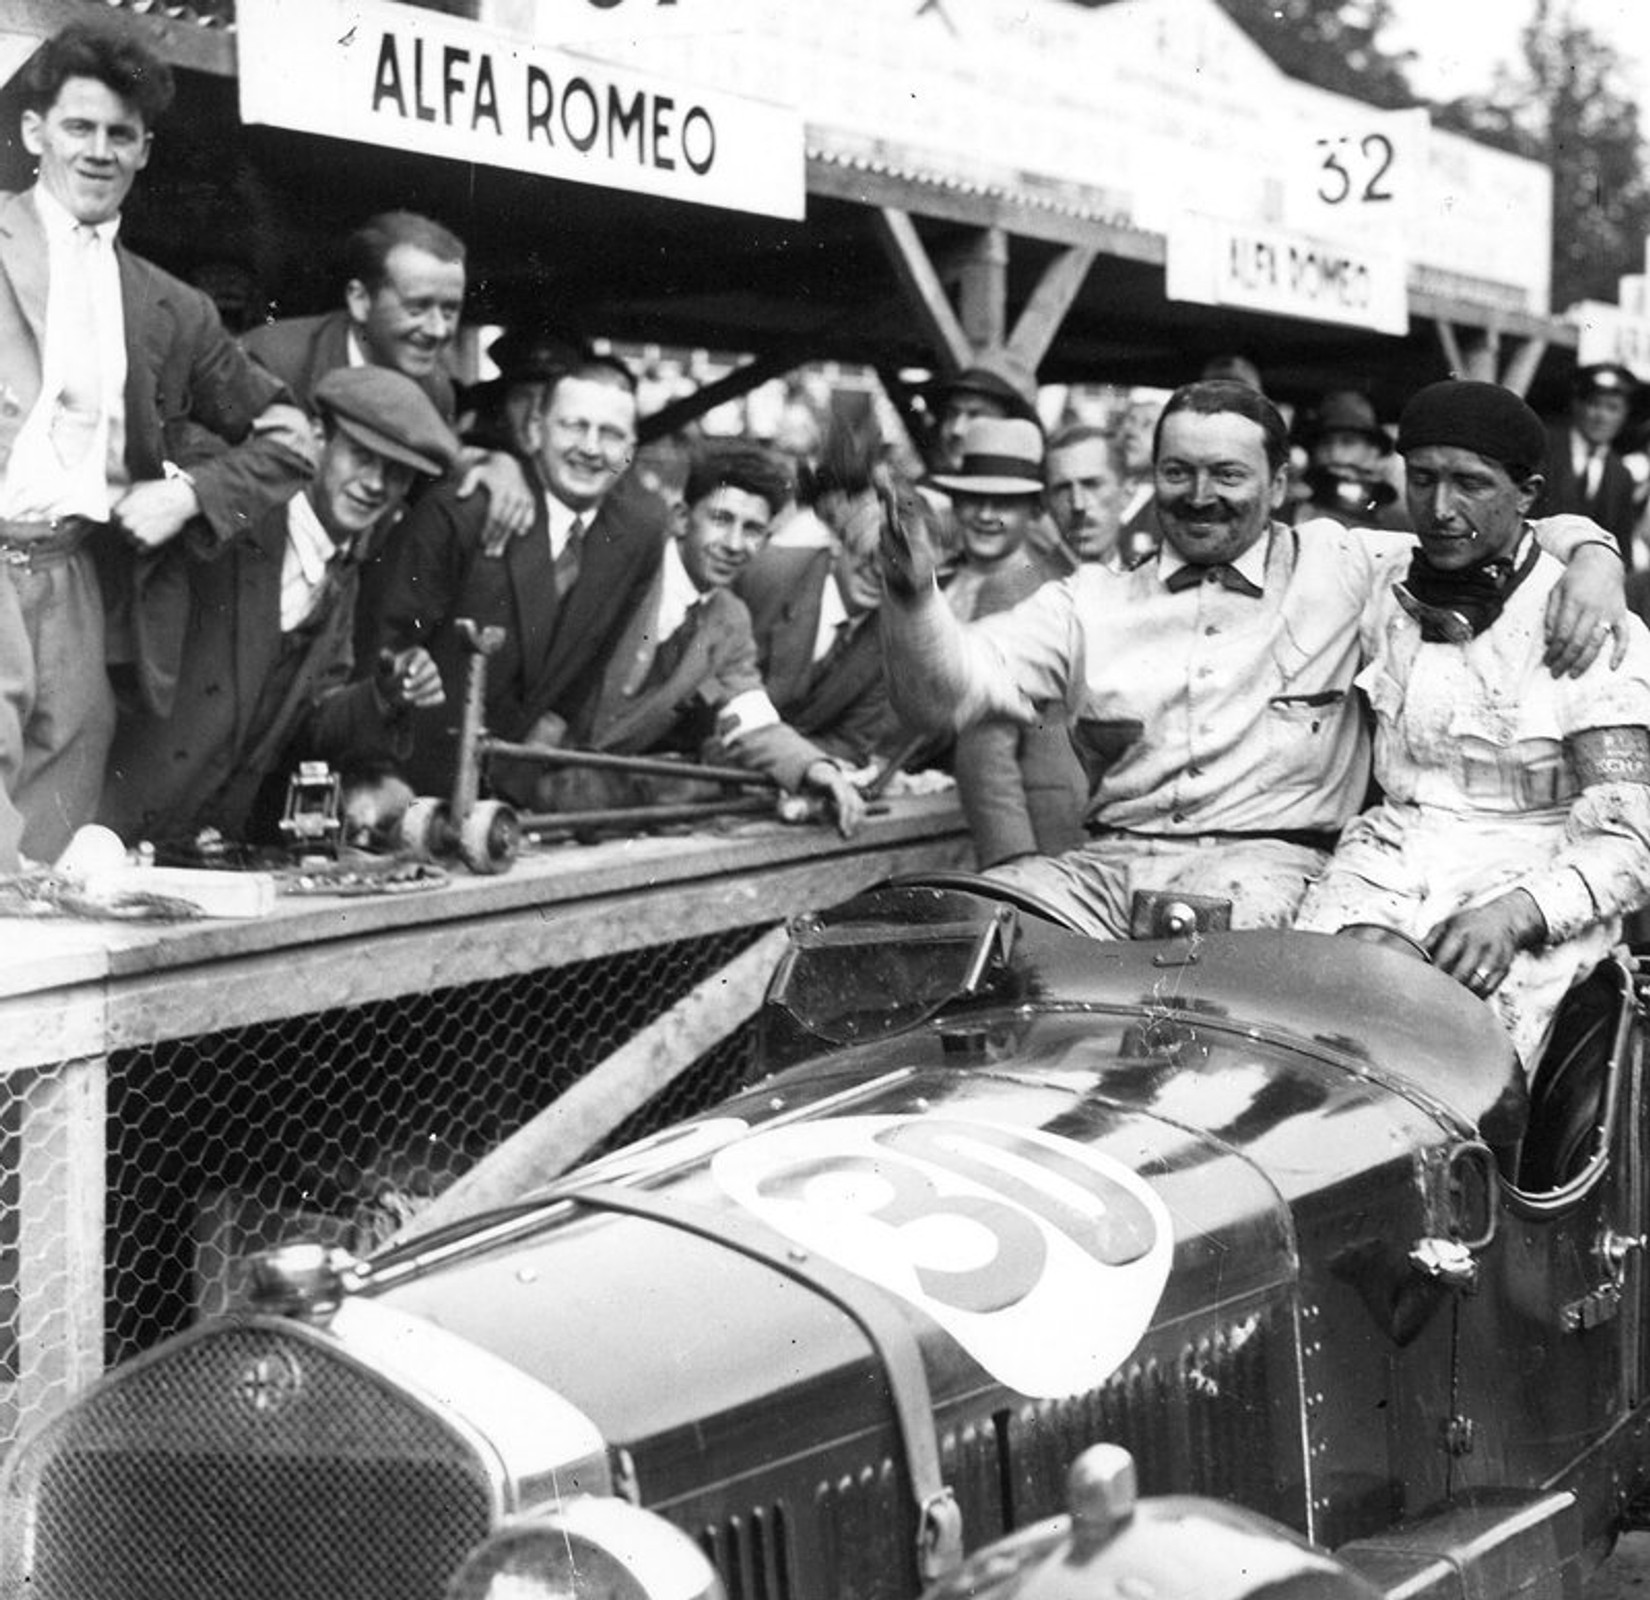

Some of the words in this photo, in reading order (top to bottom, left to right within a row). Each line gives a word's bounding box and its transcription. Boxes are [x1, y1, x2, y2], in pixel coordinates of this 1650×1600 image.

[371, 32, 502, 136] ALFA
[527, 64, 716, 176] ROMEO
[1316, 133, 1394, 204] 32
[757, 1119, 1157, 1314] 30
